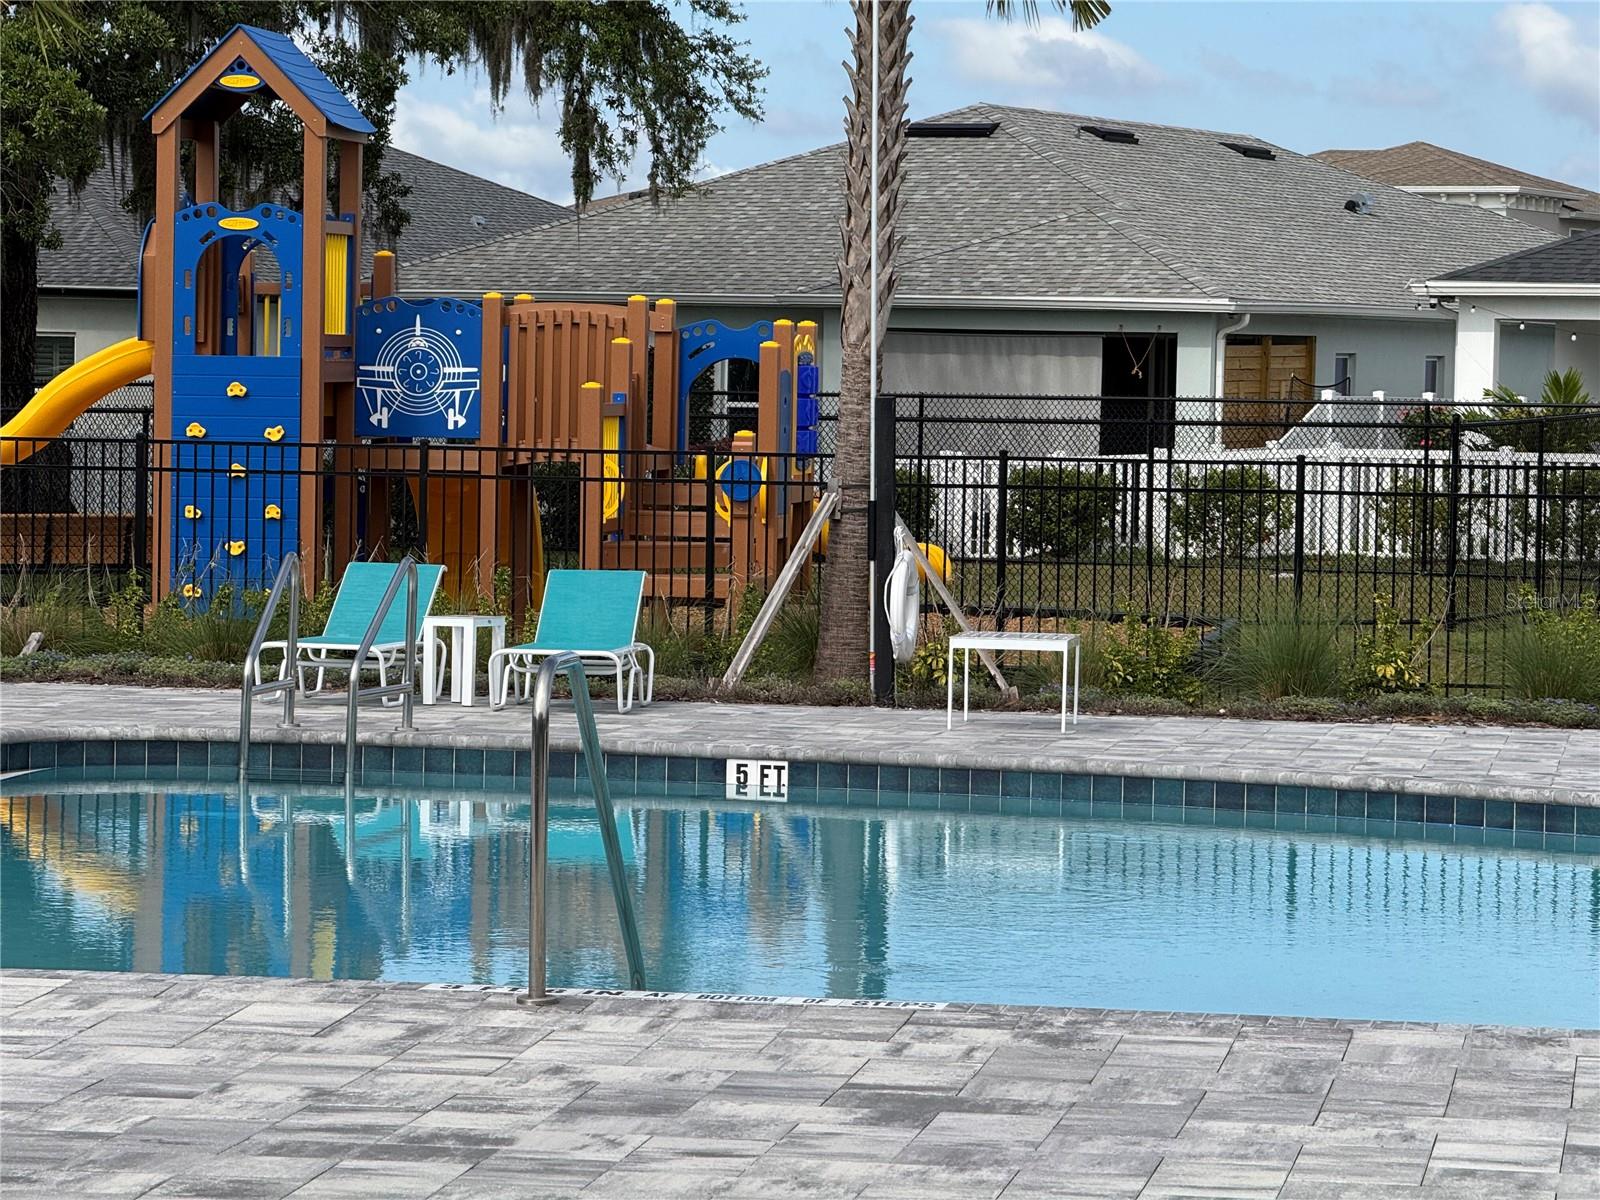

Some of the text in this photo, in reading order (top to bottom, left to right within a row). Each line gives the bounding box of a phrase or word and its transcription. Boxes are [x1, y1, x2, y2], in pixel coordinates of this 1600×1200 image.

[735, 763, 749, 785] 5
[695, 993, 779, 1003] BOTTOM
[851, 1000, 938, 1009] STEPS
